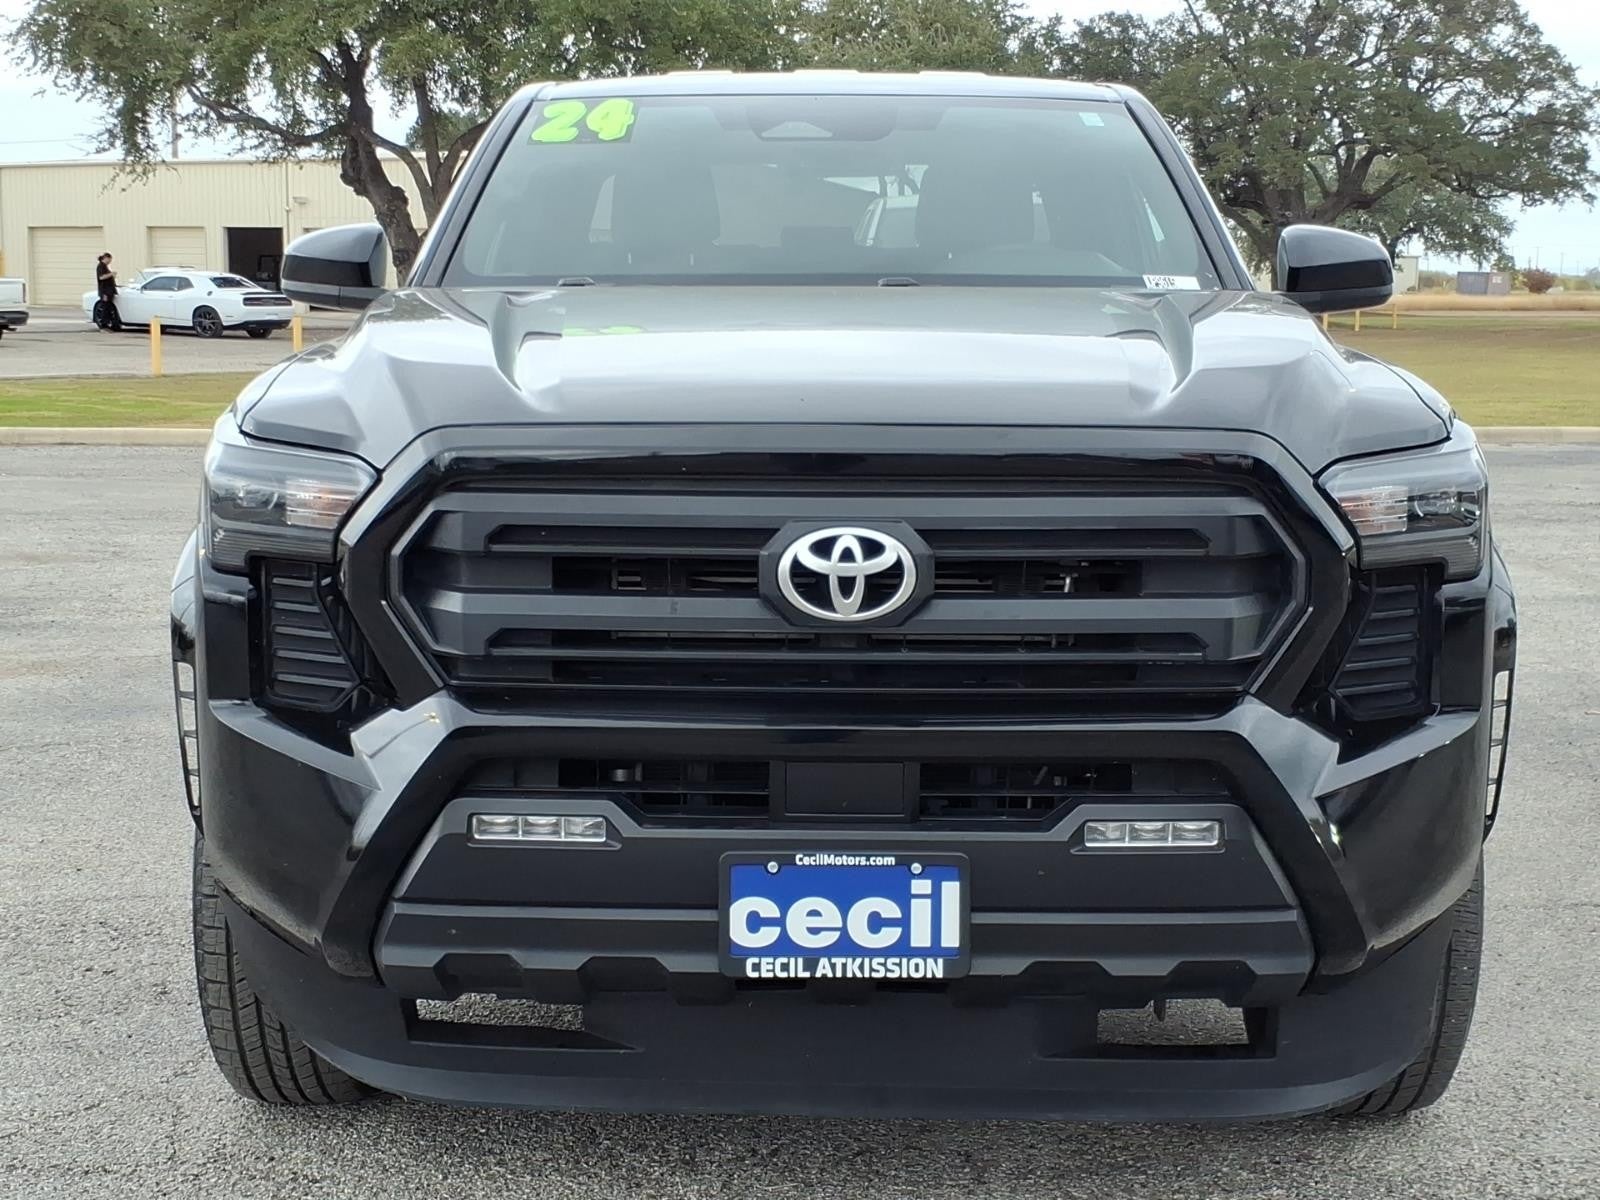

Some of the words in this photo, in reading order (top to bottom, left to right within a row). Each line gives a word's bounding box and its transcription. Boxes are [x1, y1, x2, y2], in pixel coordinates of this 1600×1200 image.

[531, 98, 634, 142] 24
[795, 854, 896, 866] CecilMotors.com
[729, 879, 960, 948] cecil
[745, 957, 810, 978] CECIL
[815, 957, 944, 979] ATKISSION
